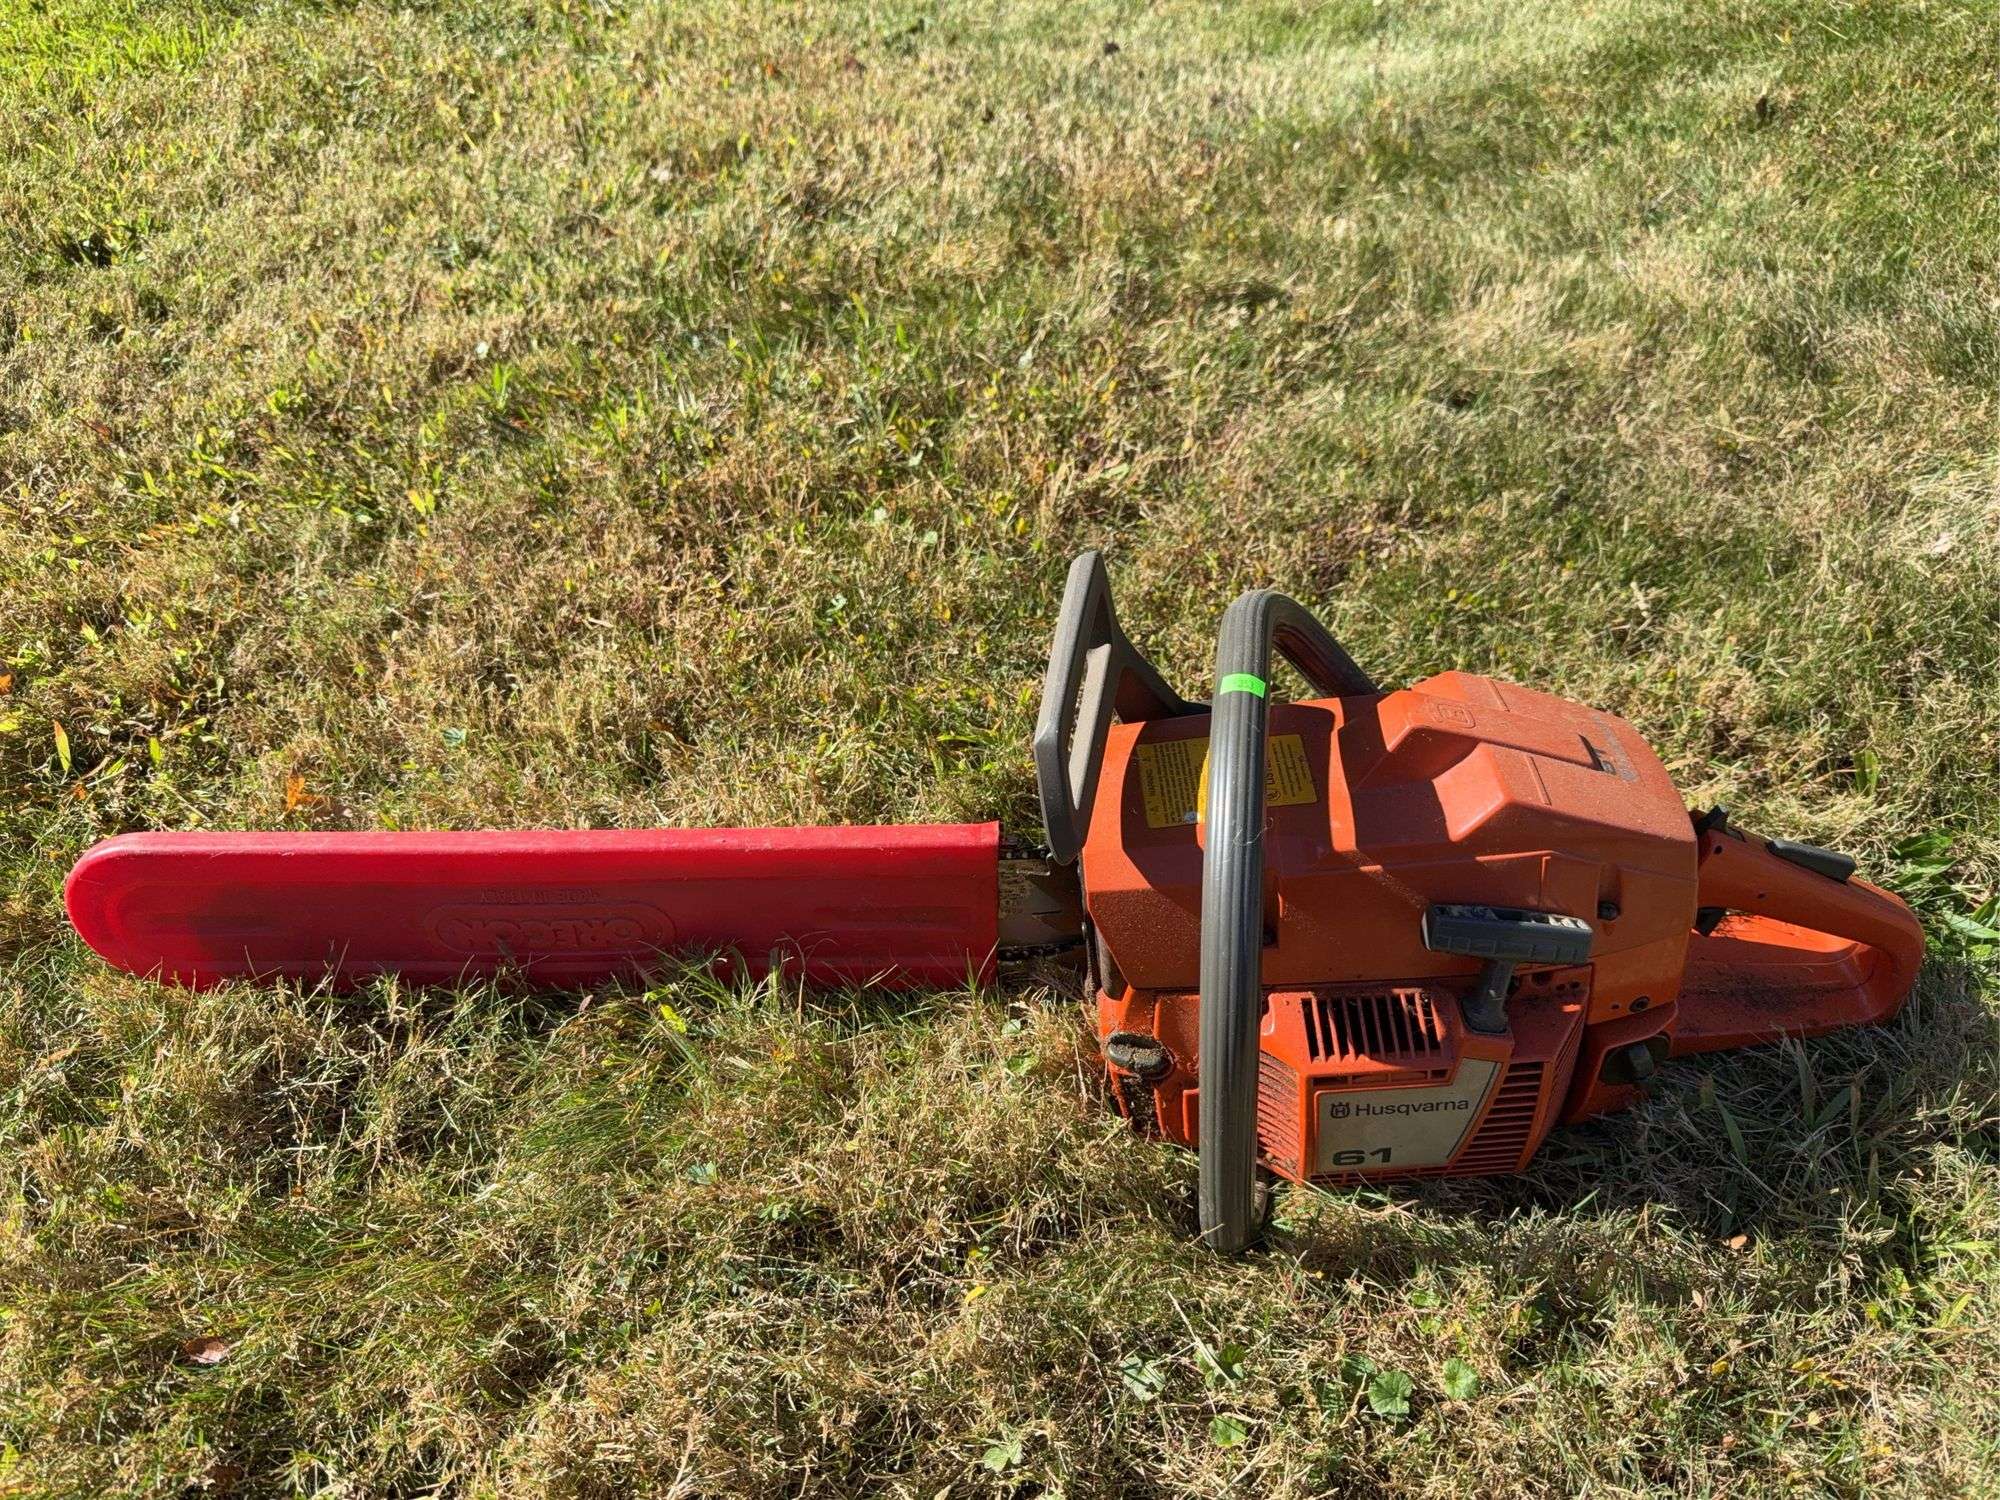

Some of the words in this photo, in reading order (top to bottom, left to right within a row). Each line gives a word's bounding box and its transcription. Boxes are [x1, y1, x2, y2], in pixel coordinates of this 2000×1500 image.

[435, 916, 647, 947] OREGON
[1355, 1099, 1469, 1117] Husqvarna
[1332, 1147, 1392, 1165] 61
